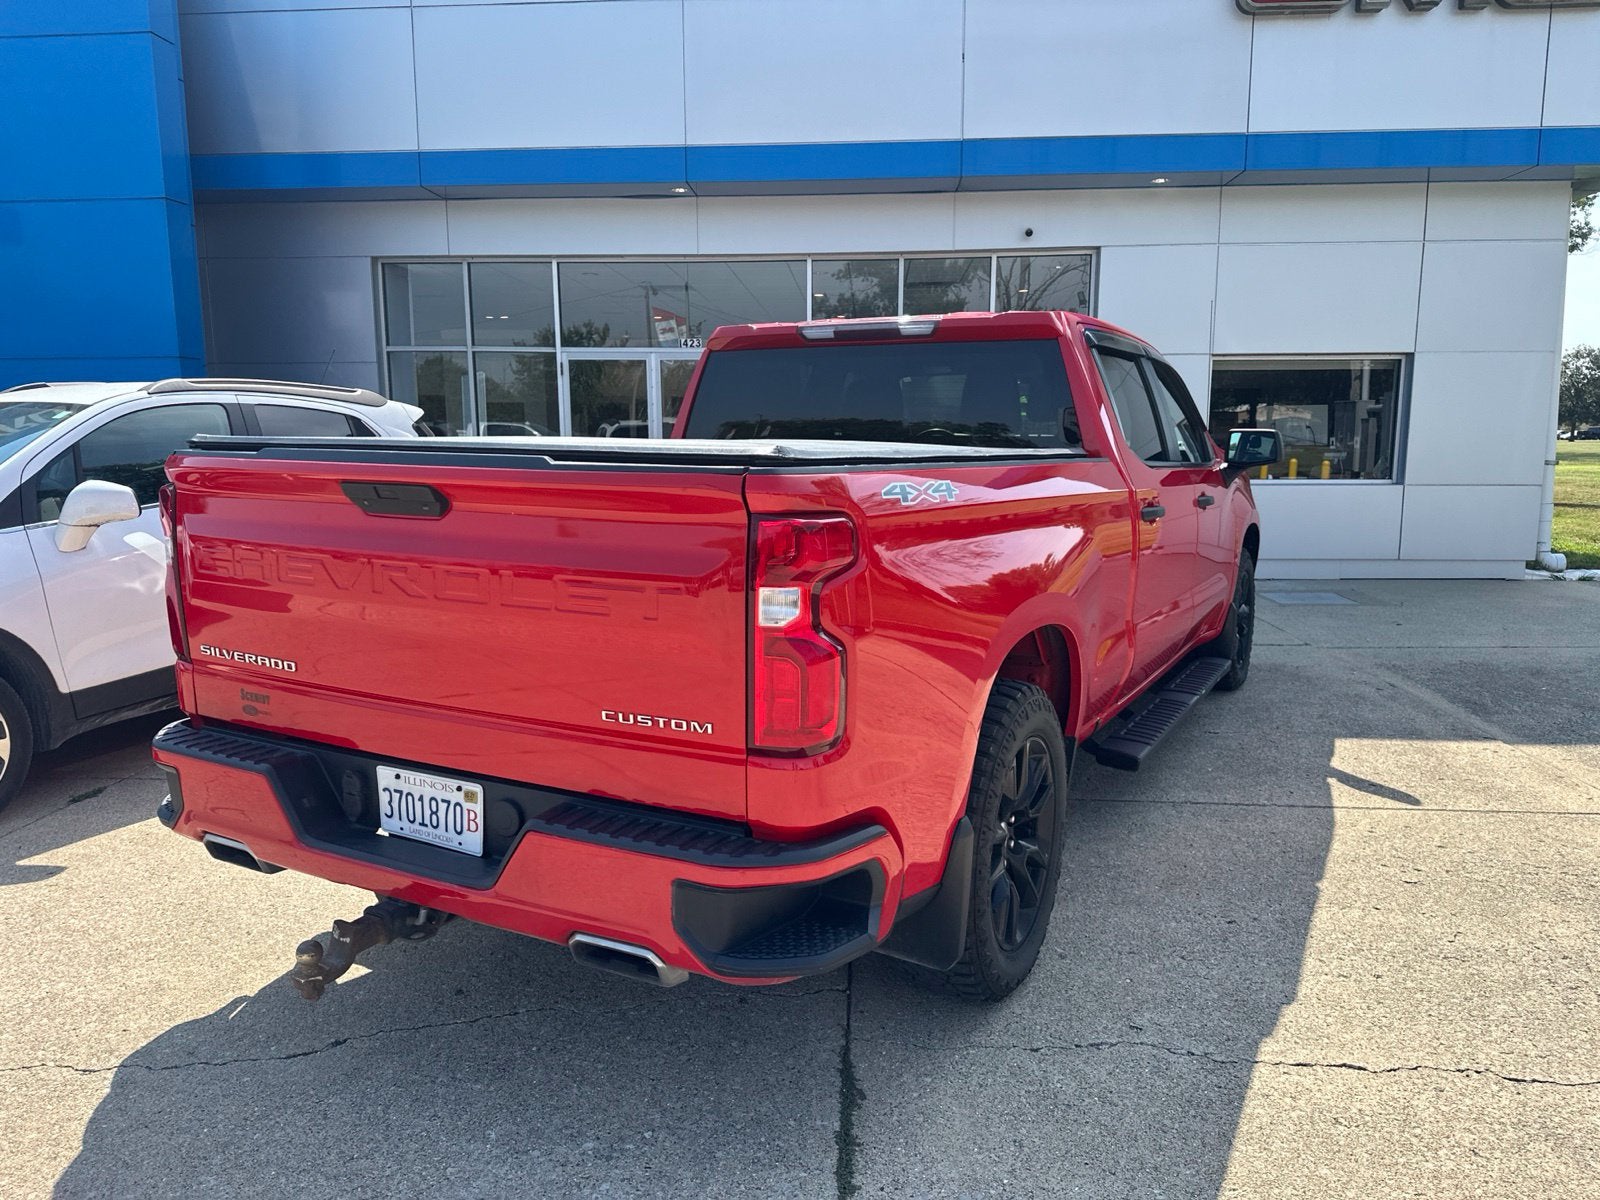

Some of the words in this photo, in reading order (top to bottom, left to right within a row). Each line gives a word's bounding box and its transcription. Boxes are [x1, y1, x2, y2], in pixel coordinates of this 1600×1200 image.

[196, 541, 690, 621] CHEVROLET
[200, 645, 297, 672] SILVERADO
[601, 710, 713, 735] CUSTOM
[404, 775, 455, 793] ILLINOIS
